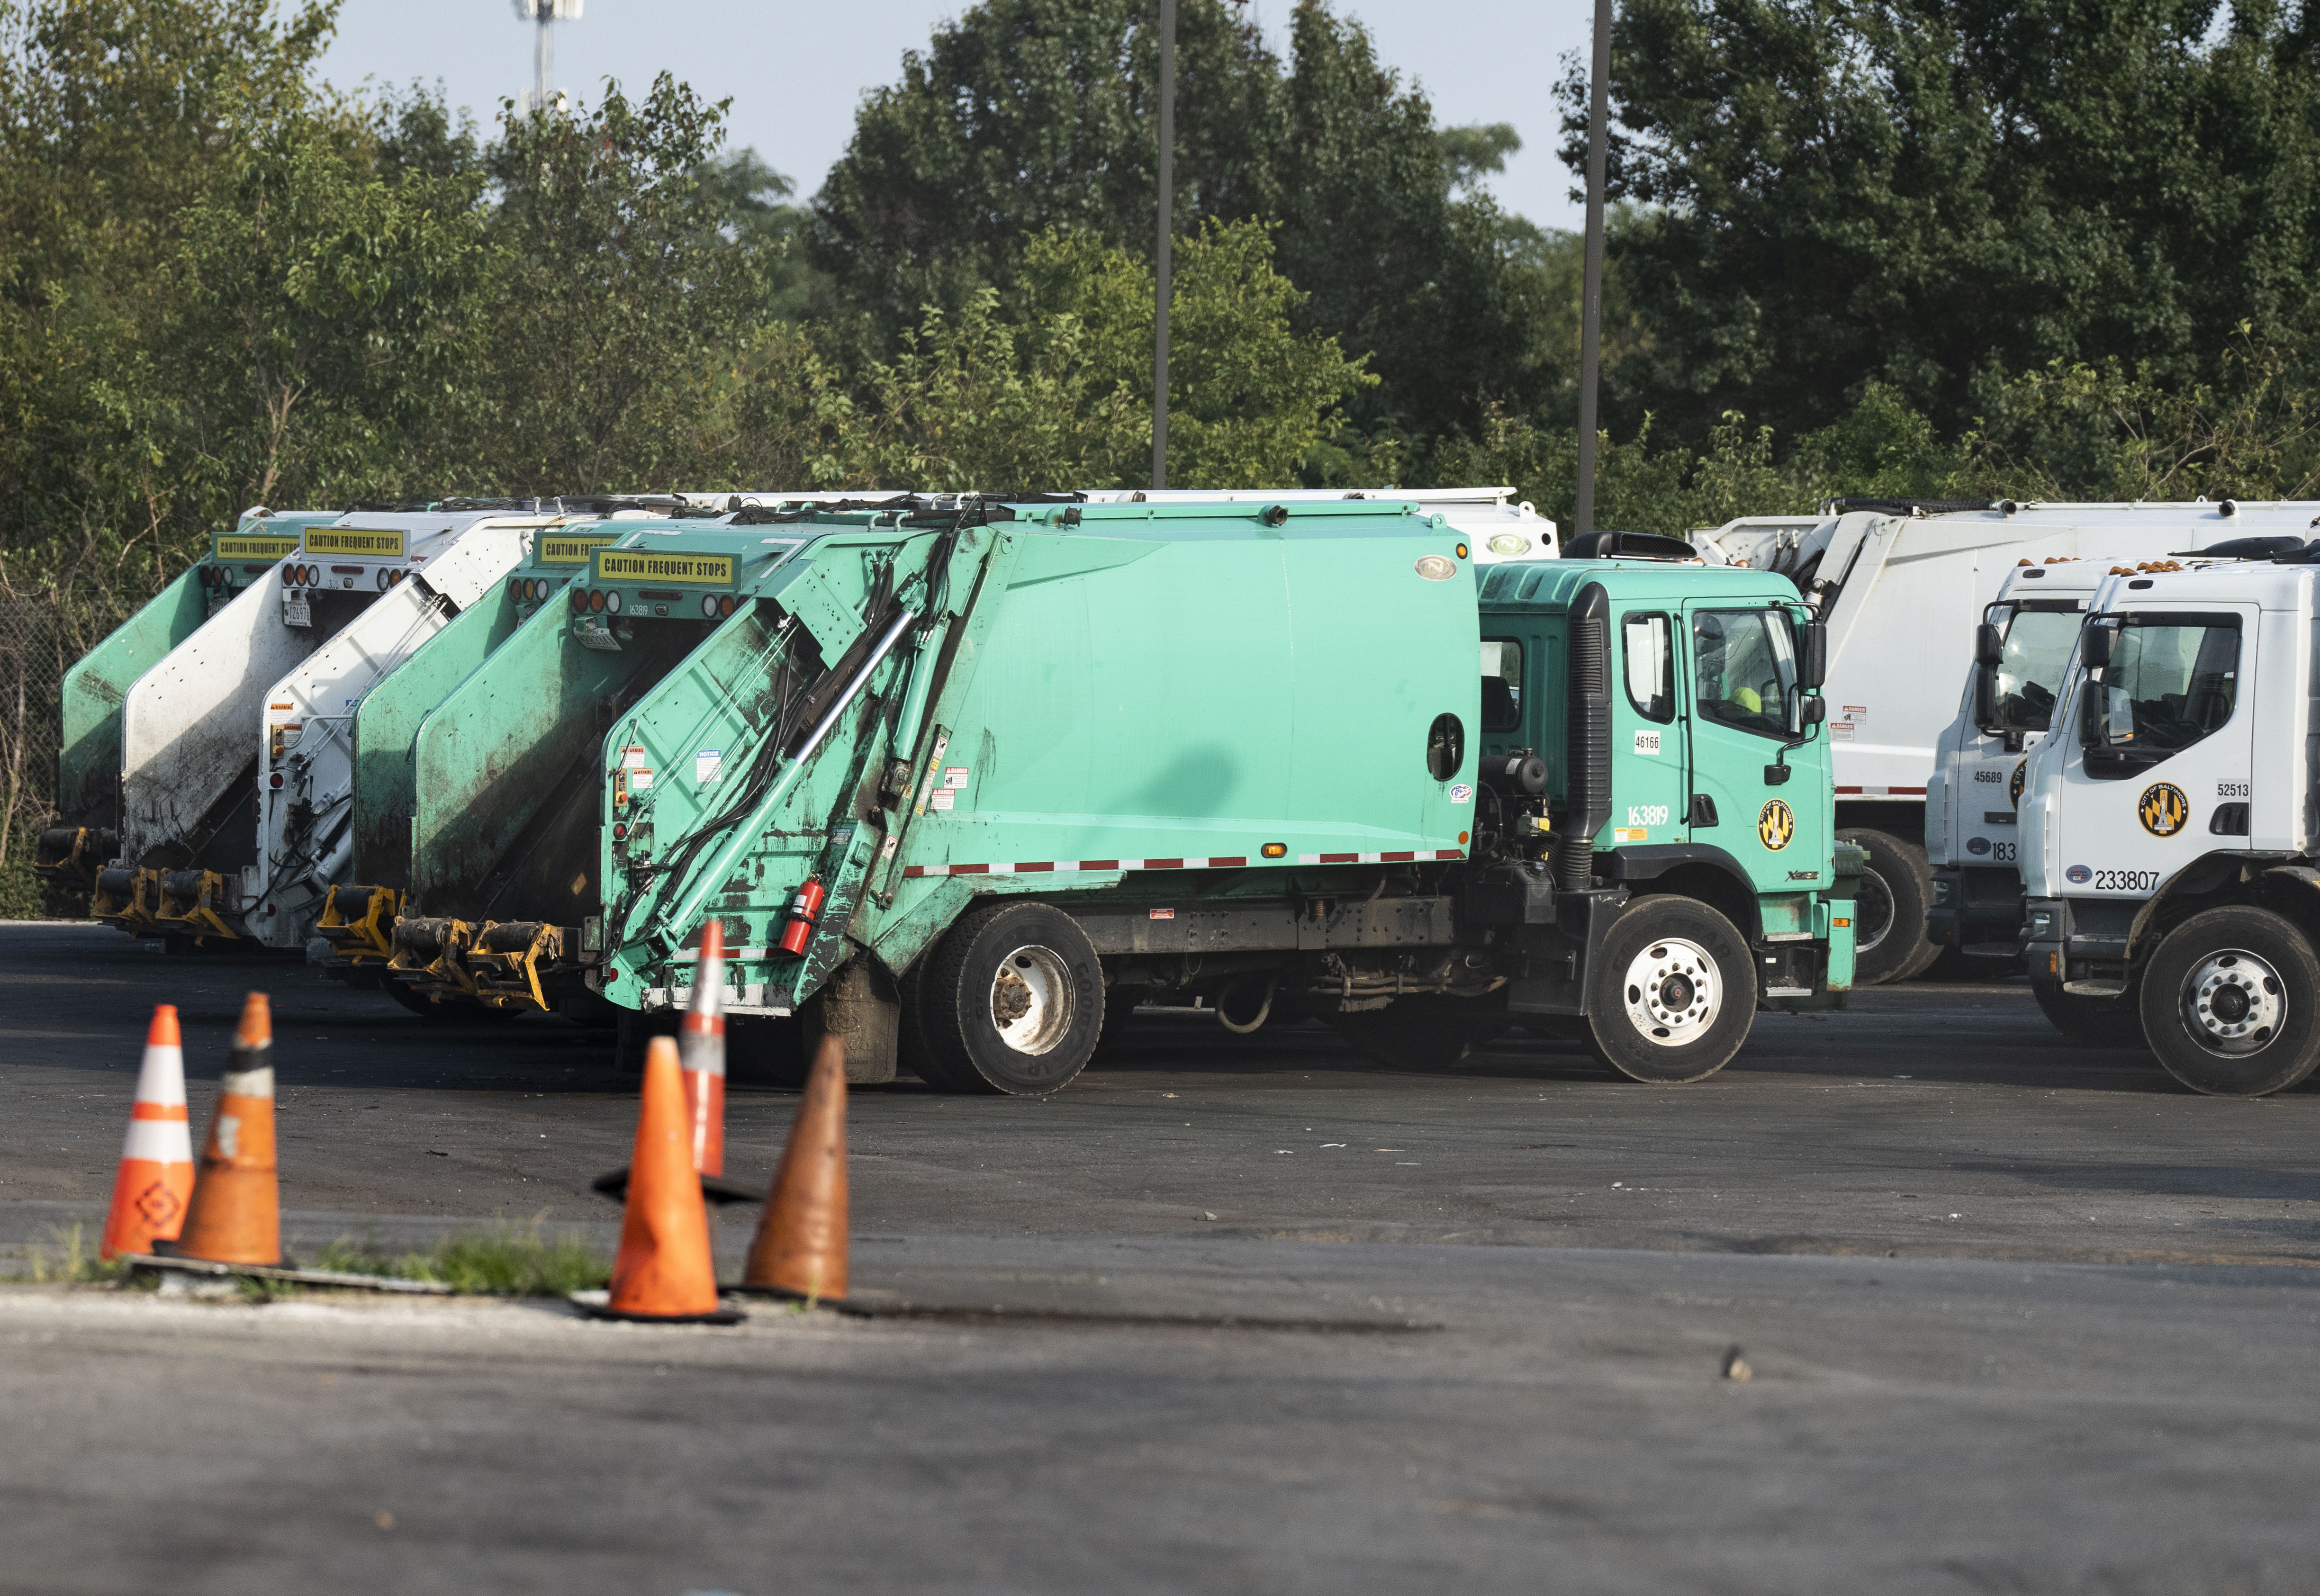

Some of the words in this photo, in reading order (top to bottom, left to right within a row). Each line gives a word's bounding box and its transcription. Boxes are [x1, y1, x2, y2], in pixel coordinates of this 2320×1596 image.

[221, 542, 247, 553] CAUTION
[249, 542, 280, 554] FREQUENT
[310, 534, 339, 548] CAUTION
[341, 535, 374, 550] FREQUENT
[376, 537, 398, 550] STOPS
[546, 543, 578, 556] CAUTION
[605, 558, 644, 573] CAUTION
[648, 560, 694, 576] FREQUENT
[696, 562, 726, 577] STOPS
[289, 606, 306, 620] 12697
[629, 604, 648, 615] 163819
[1635, 736, 1659, 748] 46166
[1974, 771, 2002, 784] 45689
[2141, 793, 2150, 806] CITY
[2149, 785, 2158, 793] OF
[2158, 784, 2187, 808] BALTIMORE
[2217, 784, 2249, 796] 52513
[1627, 805, 1669, 826] 163819
[1772, 801, 1793, 823] BALTIMORE
[2095, 870, 2160, 891] 233807
